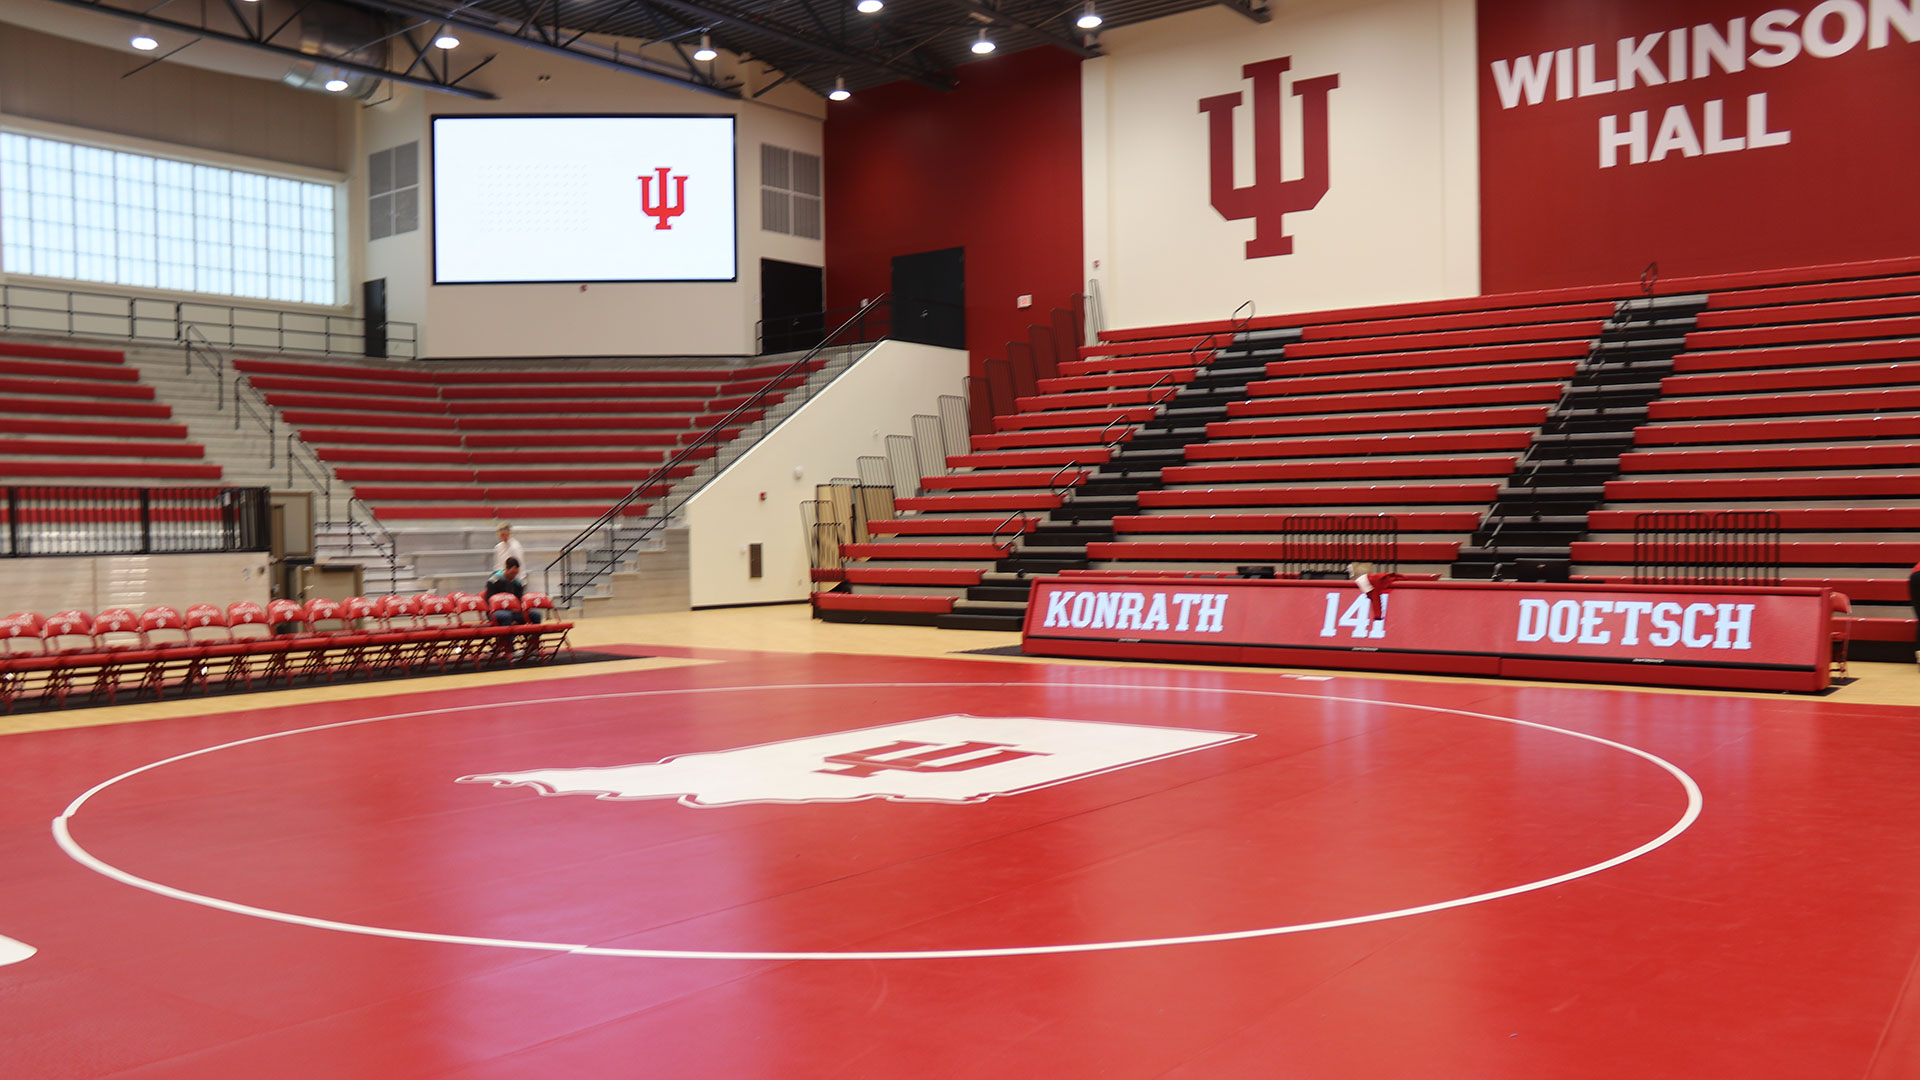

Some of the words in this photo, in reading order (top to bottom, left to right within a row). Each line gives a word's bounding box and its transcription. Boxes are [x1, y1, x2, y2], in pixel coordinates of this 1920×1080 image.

[1491, 0, 1920, 110] WILKINSON
[1599, 92, 1791, 169] HALL
[1043, 591, 1229, 632] KONRATH
[1516, 599, 1756, 650] DOETSCH
